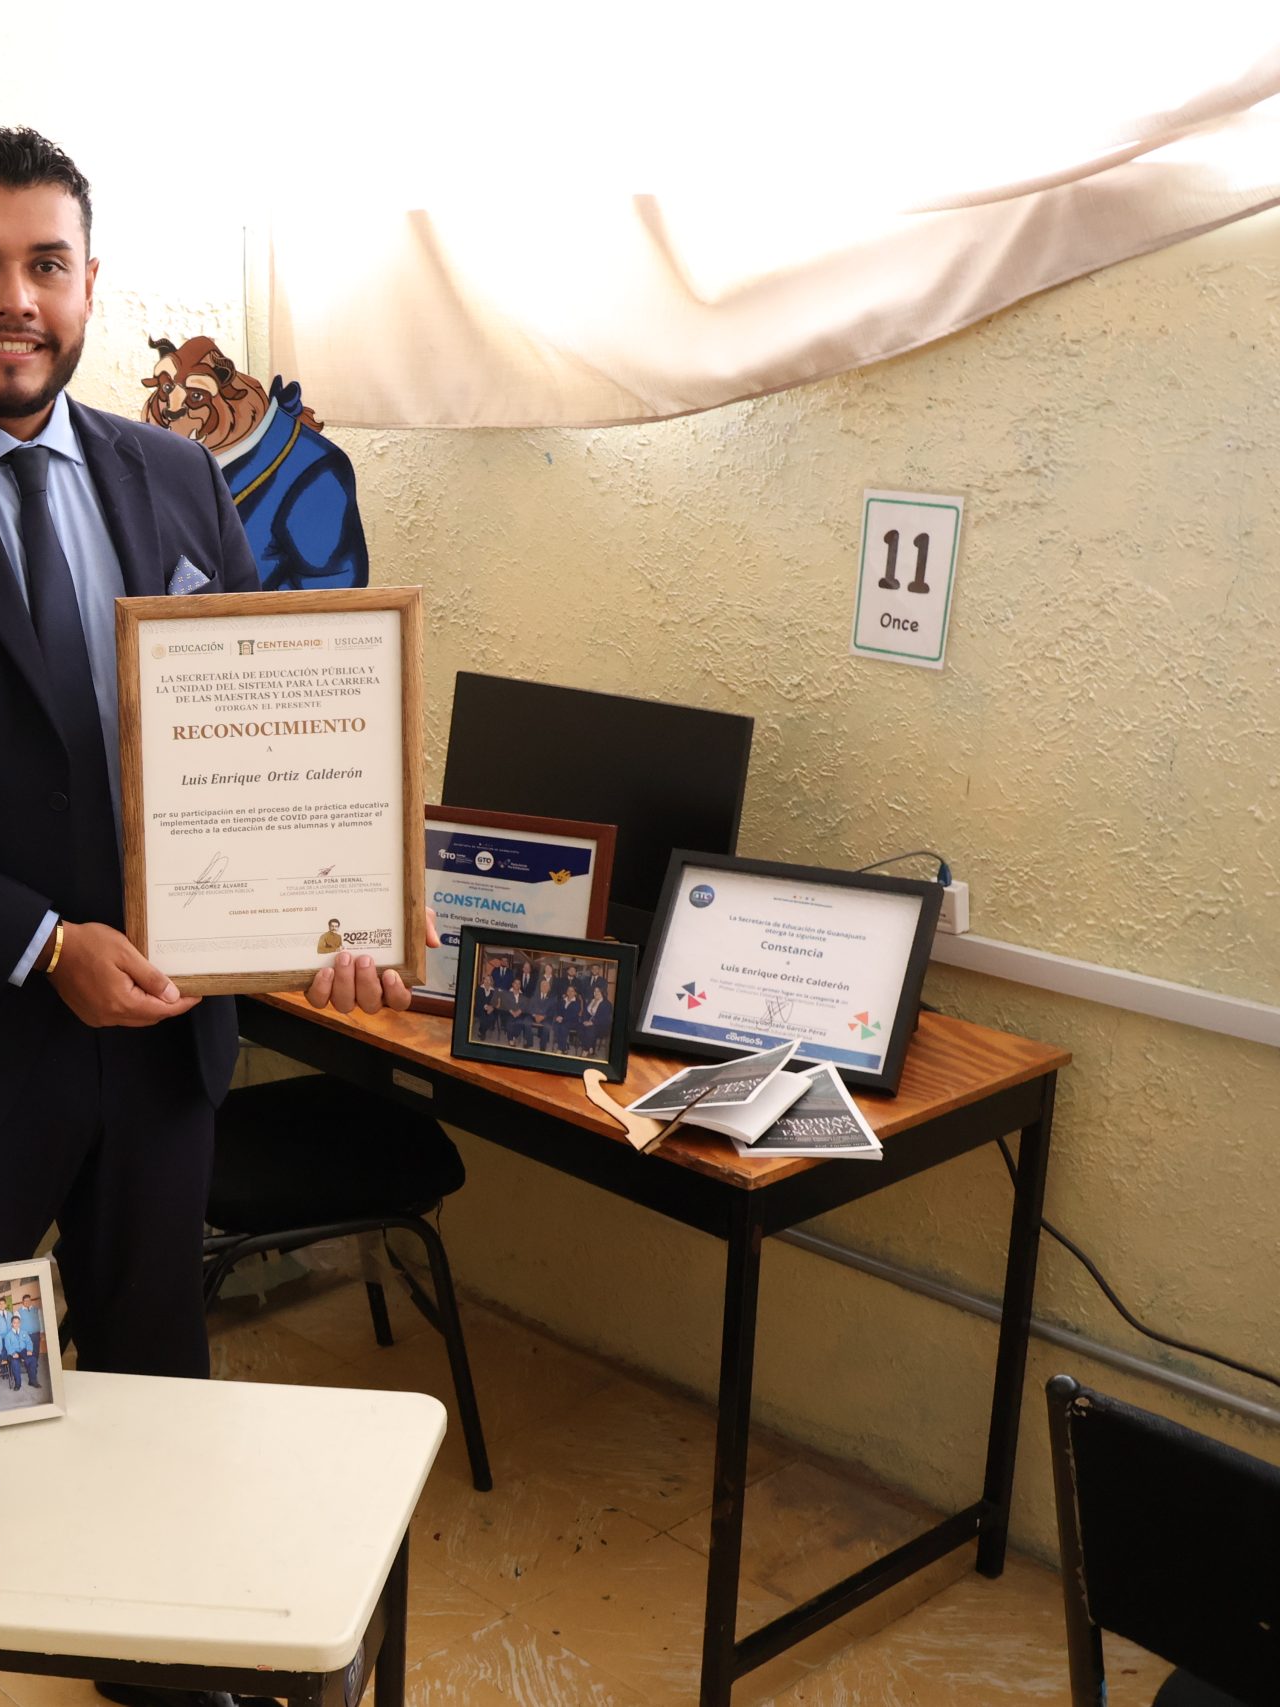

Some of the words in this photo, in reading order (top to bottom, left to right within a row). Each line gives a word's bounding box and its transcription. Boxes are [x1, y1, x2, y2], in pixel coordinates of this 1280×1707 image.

[878, 529, 930, 594] 11
[880, 612, 919, 632] Once
[168, 642, 224, 653] EDUCACIÓN
[334, 636, 382, 646] USICAMM
[161, 675, 174, 683] LA
[176, 671, 240, 682] SECRETARÍA
[242, 671, 256, 679] DE
[259, 667, 319, 678] EDUCACIÓN
[322, 666, 365, 676] PÚBLICA
[368, 666, 375, 674] Y
[156, 686, 169, 694] LA
[172, 684, 213, 693] UNIDAD
[216, 683, 236, 691] DEL
[238, 680, 283, 690] SISTEMA
[286, 679, 313, 688] PARA
[316, 678, 329, 687] LA
[331, 676, 380, 686] CARRERA
[176, 695, 190, 704] DE
[192, 694, 212, 703] LAS
[213, 691, 271, 702] MAESTRAS
[272, 691, 280, 699] Y
[281, 690, 302, 698] LOS
[303, 687, 361, 698] MAESTROS
[215, 703, 258, 712] OTORGAN
[261, 702, 272, 710] EL
[275, 701, 322, 711] PRESENTE
[172, 717, 366, 740] RECONOCIMIENTO
[181, 774, 208, 786] Luis
[211, 772, 261, 786] Enrique
[267, 770, 300, 782] Ortiz
[306, 767, 362, 781] Calderón
[153, 811, 166, 819] por
[181, 809, 233, 819] participación
[258, 807, 290, 816] proceso
[314, 803, 347, 812] práctica
[349, 801, 389, 809] educativa
[160, 819, 219, 828] implementada
[233, 816, 266, 825] tiempos
[280, 813, 308, 822] COVID
[309, 812, 328, 821] para
[330, 811, 373, 820] garantizar
[170, 828, 204, 836] derecho
[222, 825, 263, 833] educación
[293, 822, 329, 830] alumnas
[337, 820, 373, 828] alumnos
[440, 852, 456, 860] GTO
[477, 856, 492, 864] GTO
[433, 891, 526, 915] CONSTANCIA
[450, 913, 473, 922] Enrique
[475, 916, 490, 925] Ortiz
[490, 919, 518, 929] Calderón
[343, 931, 368, 945] 2022
[765, 928, 787, 937] otorga
[796, 932, 827, 942] siguiente
[782, 922, 815, 933] Educación
[827, 930, 866, 941] Guanajuato
[760, 941, 824, 959] Constancia
[720, 963, 740, 973] Luis
[742, 967, 778, 980] Enrique
[780, 973, 804, 983] Ortiz
[806, 977, 850, 991] Calderón
